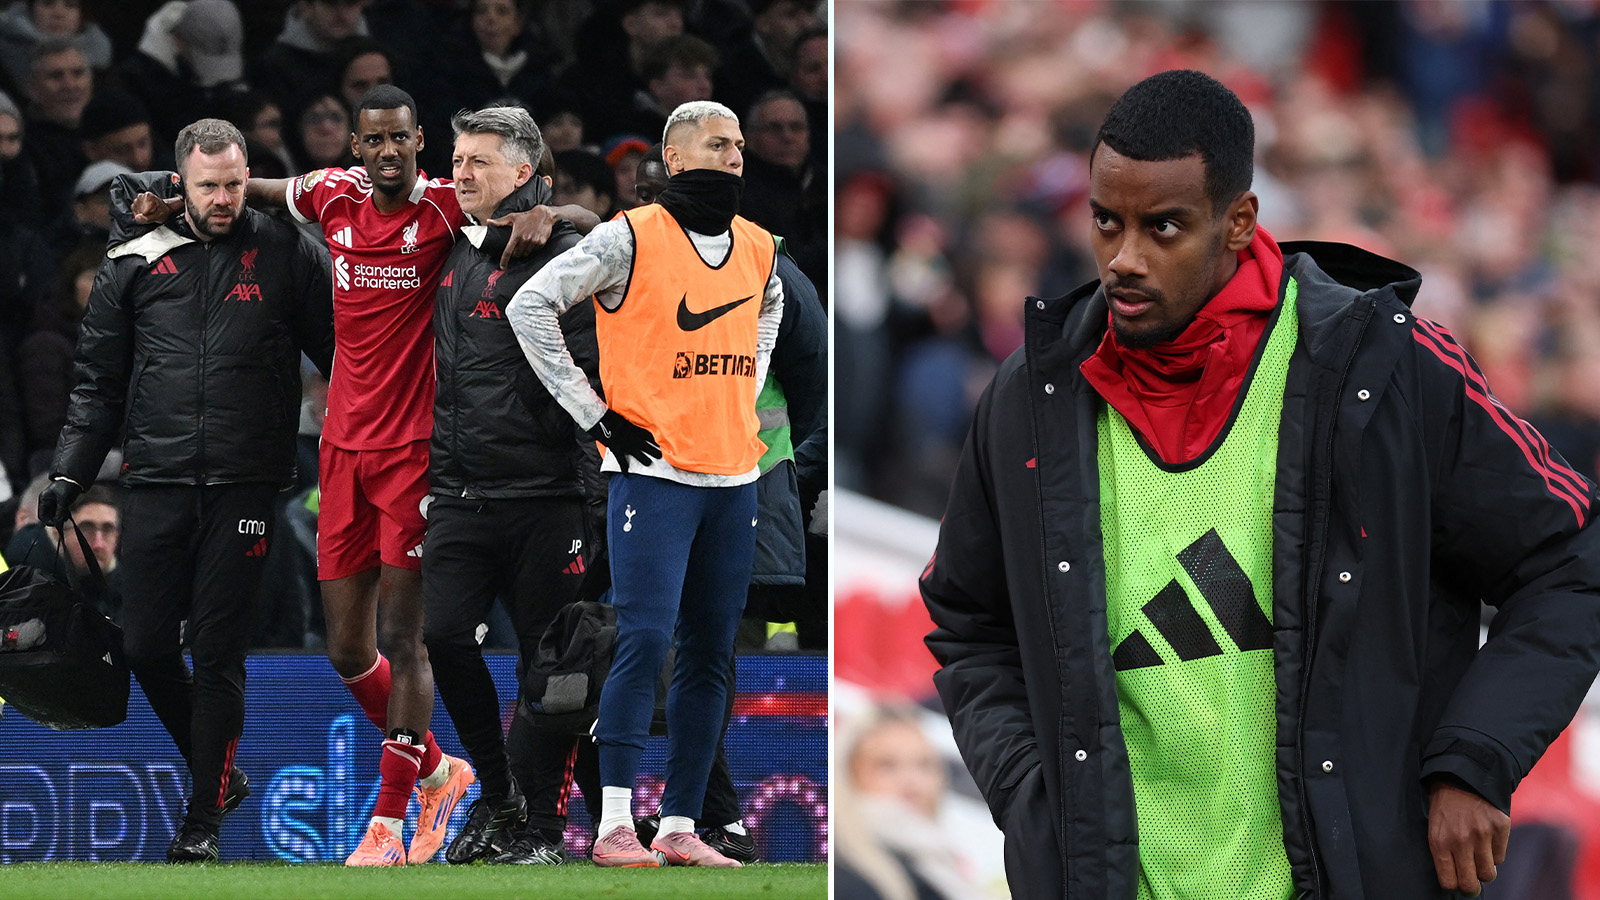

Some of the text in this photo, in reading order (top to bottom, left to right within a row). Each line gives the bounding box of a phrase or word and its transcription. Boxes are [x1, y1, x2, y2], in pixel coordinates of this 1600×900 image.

[354, 263, 416, 278] standard
[353, 275, 421, 290] chartered
[224, 283, 263, 301] AXA
[468, 299, 502, 319] AXA
[567, 539, 583, 555] JP
